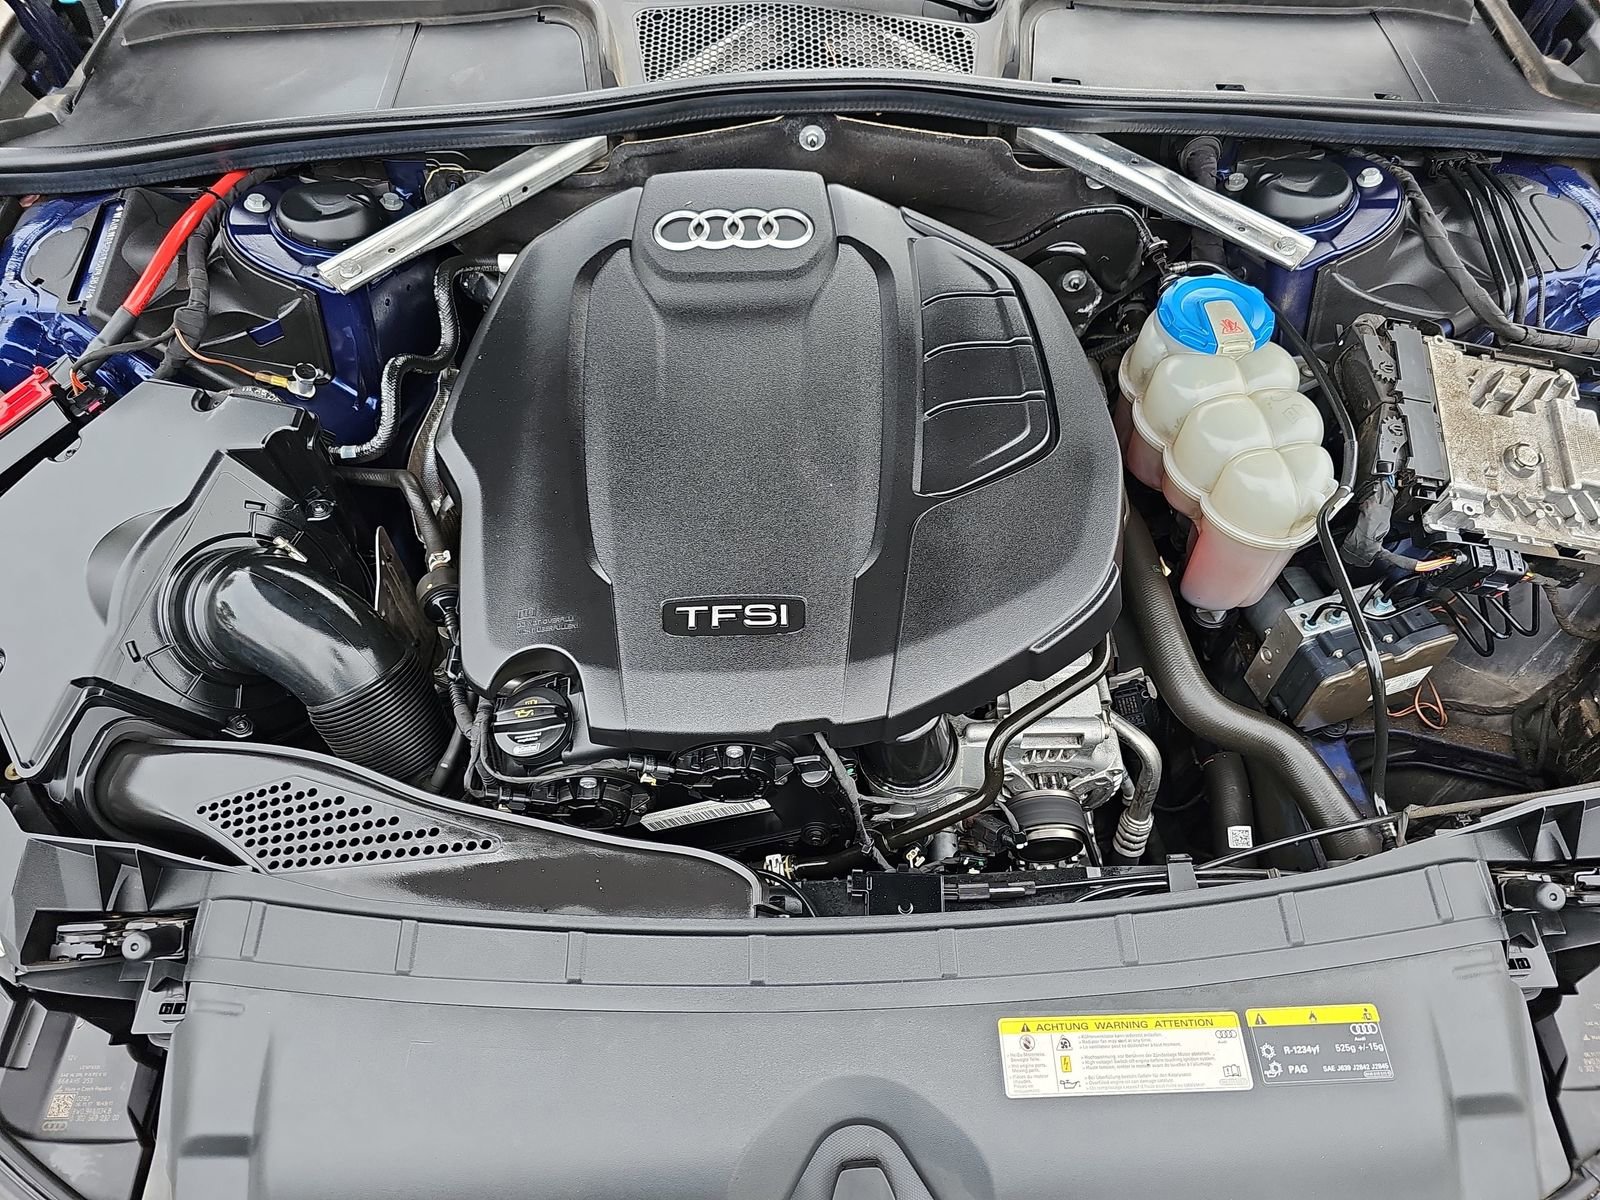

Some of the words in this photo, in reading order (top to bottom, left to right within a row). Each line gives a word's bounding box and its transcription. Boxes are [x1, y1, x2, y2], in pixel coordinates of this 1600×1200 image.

[675, 604, 789, 630] TFSI
[1036, 1022, 1089, 1032] ACHTUNG
[1094, 1020, 1148, 1030] WARNING
[1154, 1018, 1214, 1028] ATTENTION
[1283, 1045, 1320, 1055] R-1234yf
[1335, 1044, 1356, 1054] 525g
[1358, 1043, 1384, 1052] +/-15g
[1288, 1064, 1308, 1074] PAG
